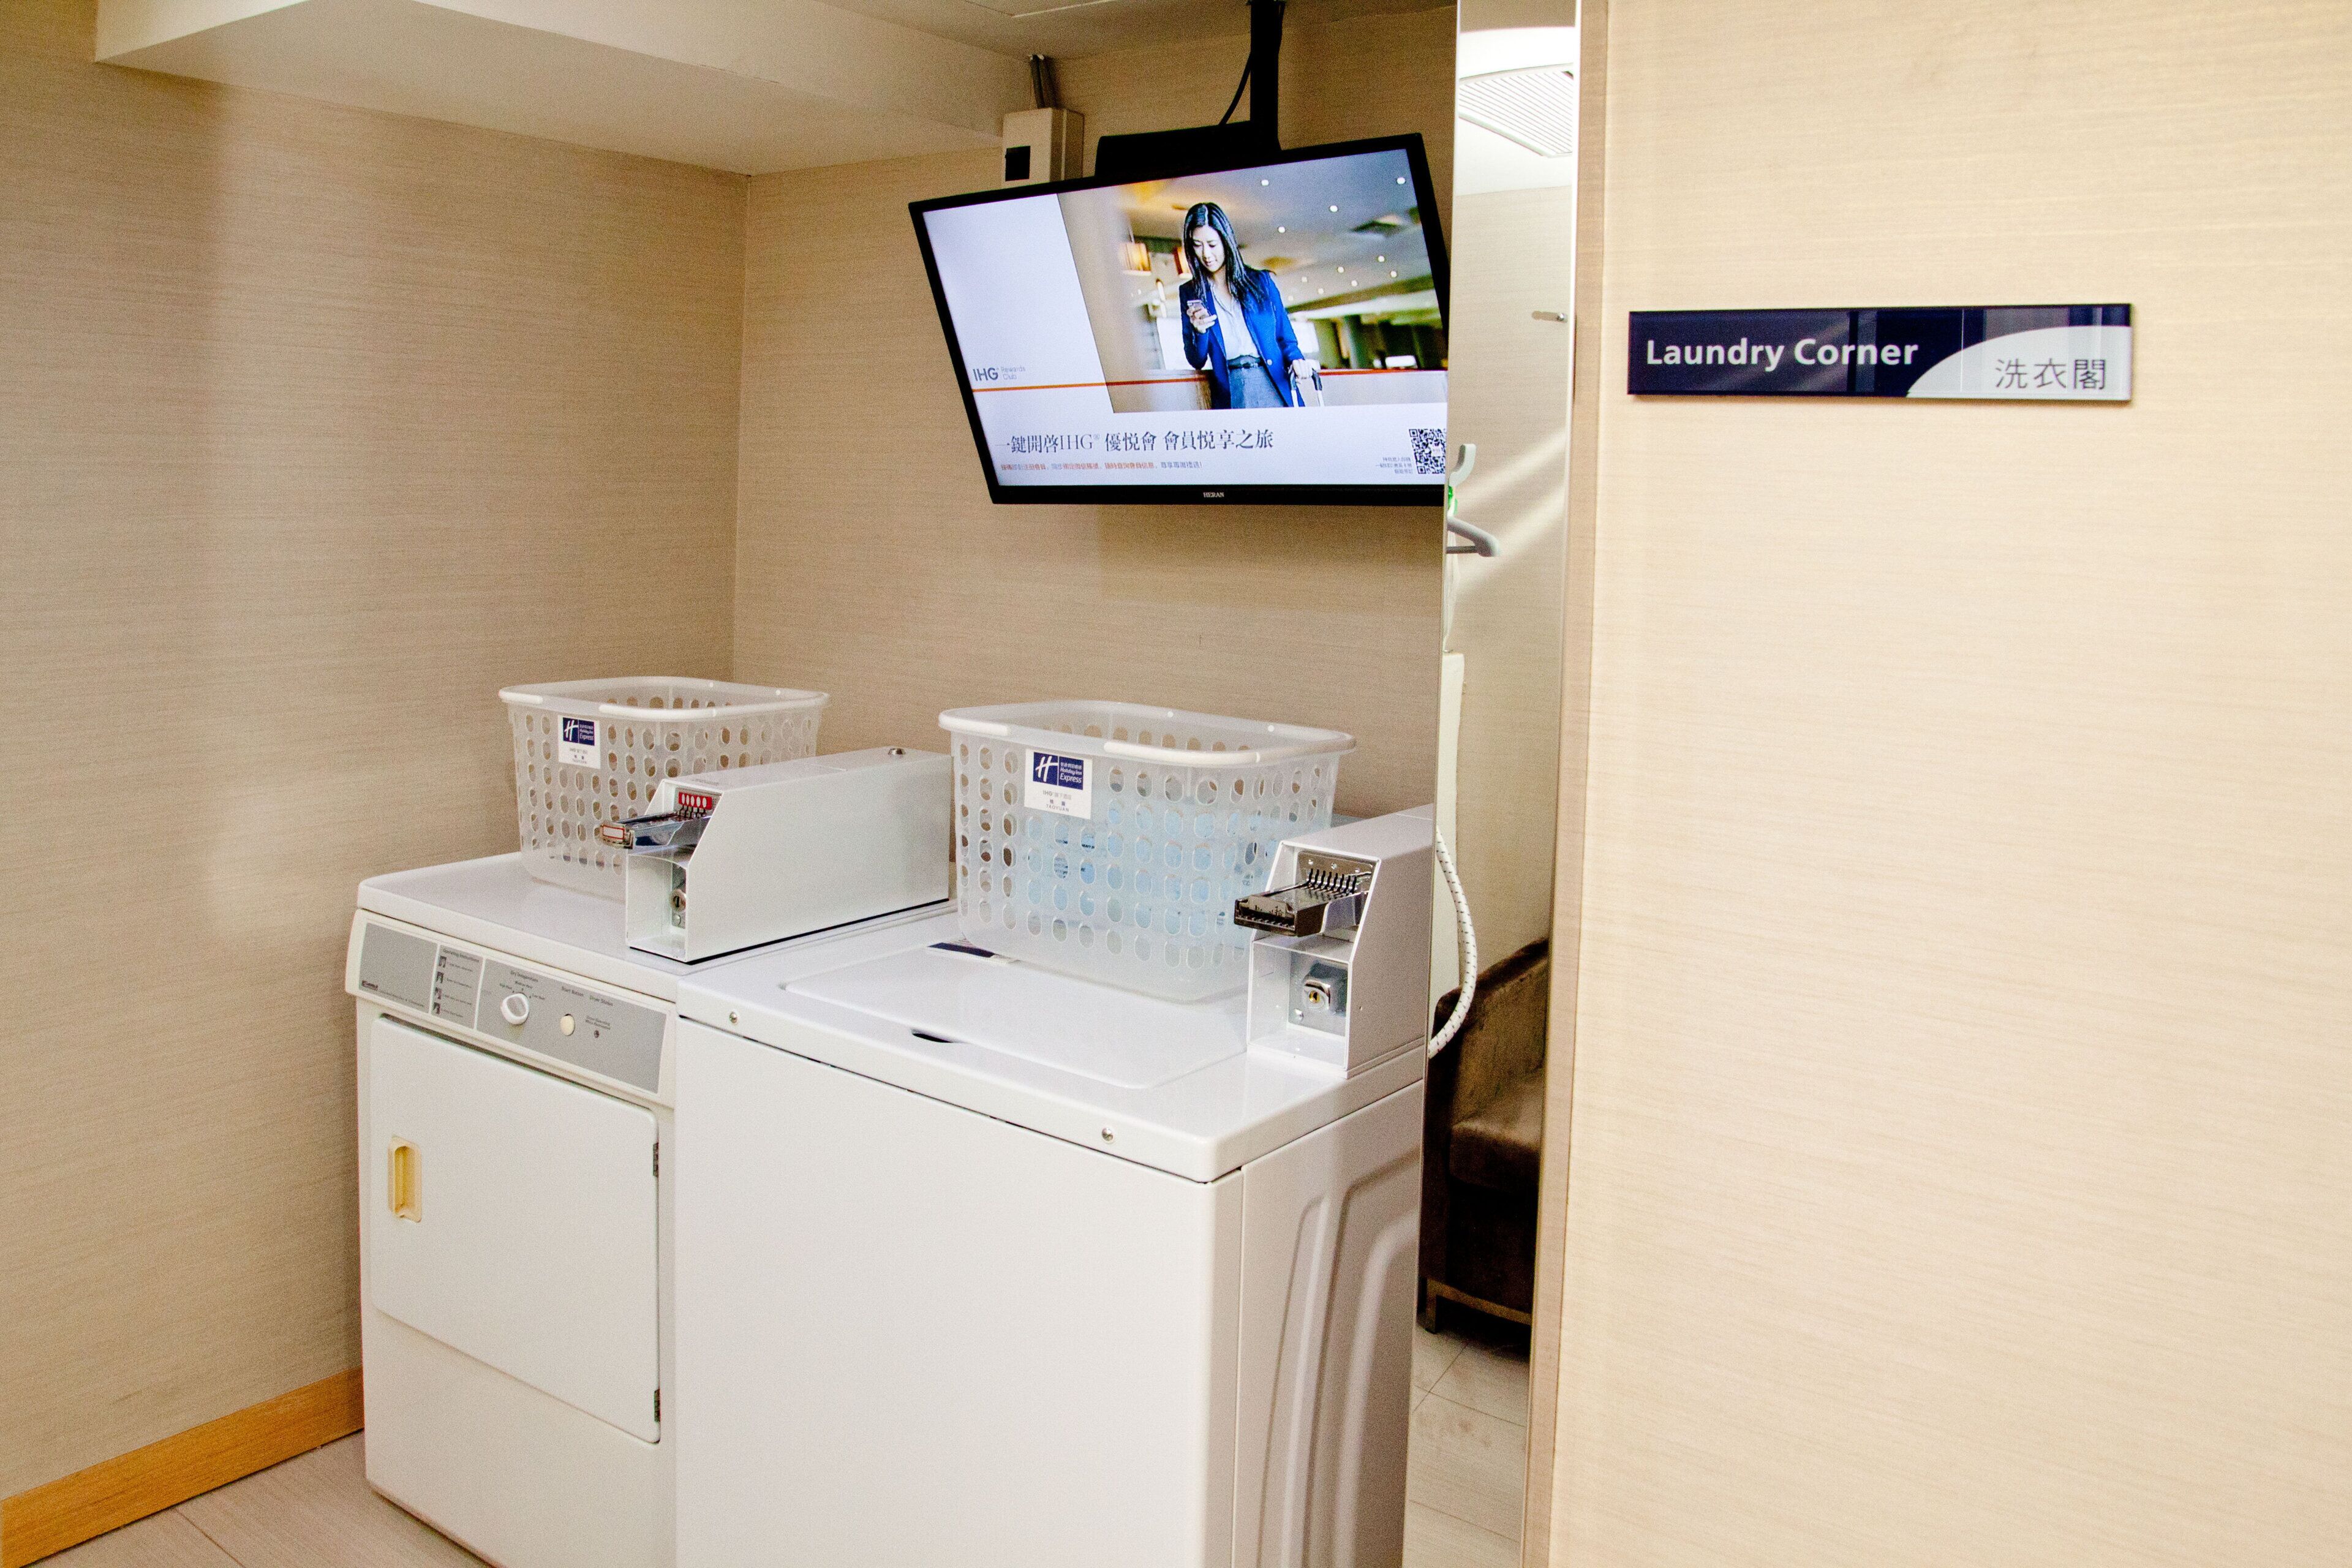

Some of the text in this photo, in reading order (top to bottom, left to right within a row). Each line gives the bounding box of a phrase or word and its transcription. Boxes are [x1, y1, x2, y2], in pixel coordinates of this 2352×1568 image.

[1647, 337, 1918, 372] Laundry Corner
[1996, 358, 2106, 390] 洗衣閣
[1060, 767, 1075, 775] Holiday
[1060, 773, 1082, 783] Express
[1046, 804, 1069, 812] TAOYUAN
